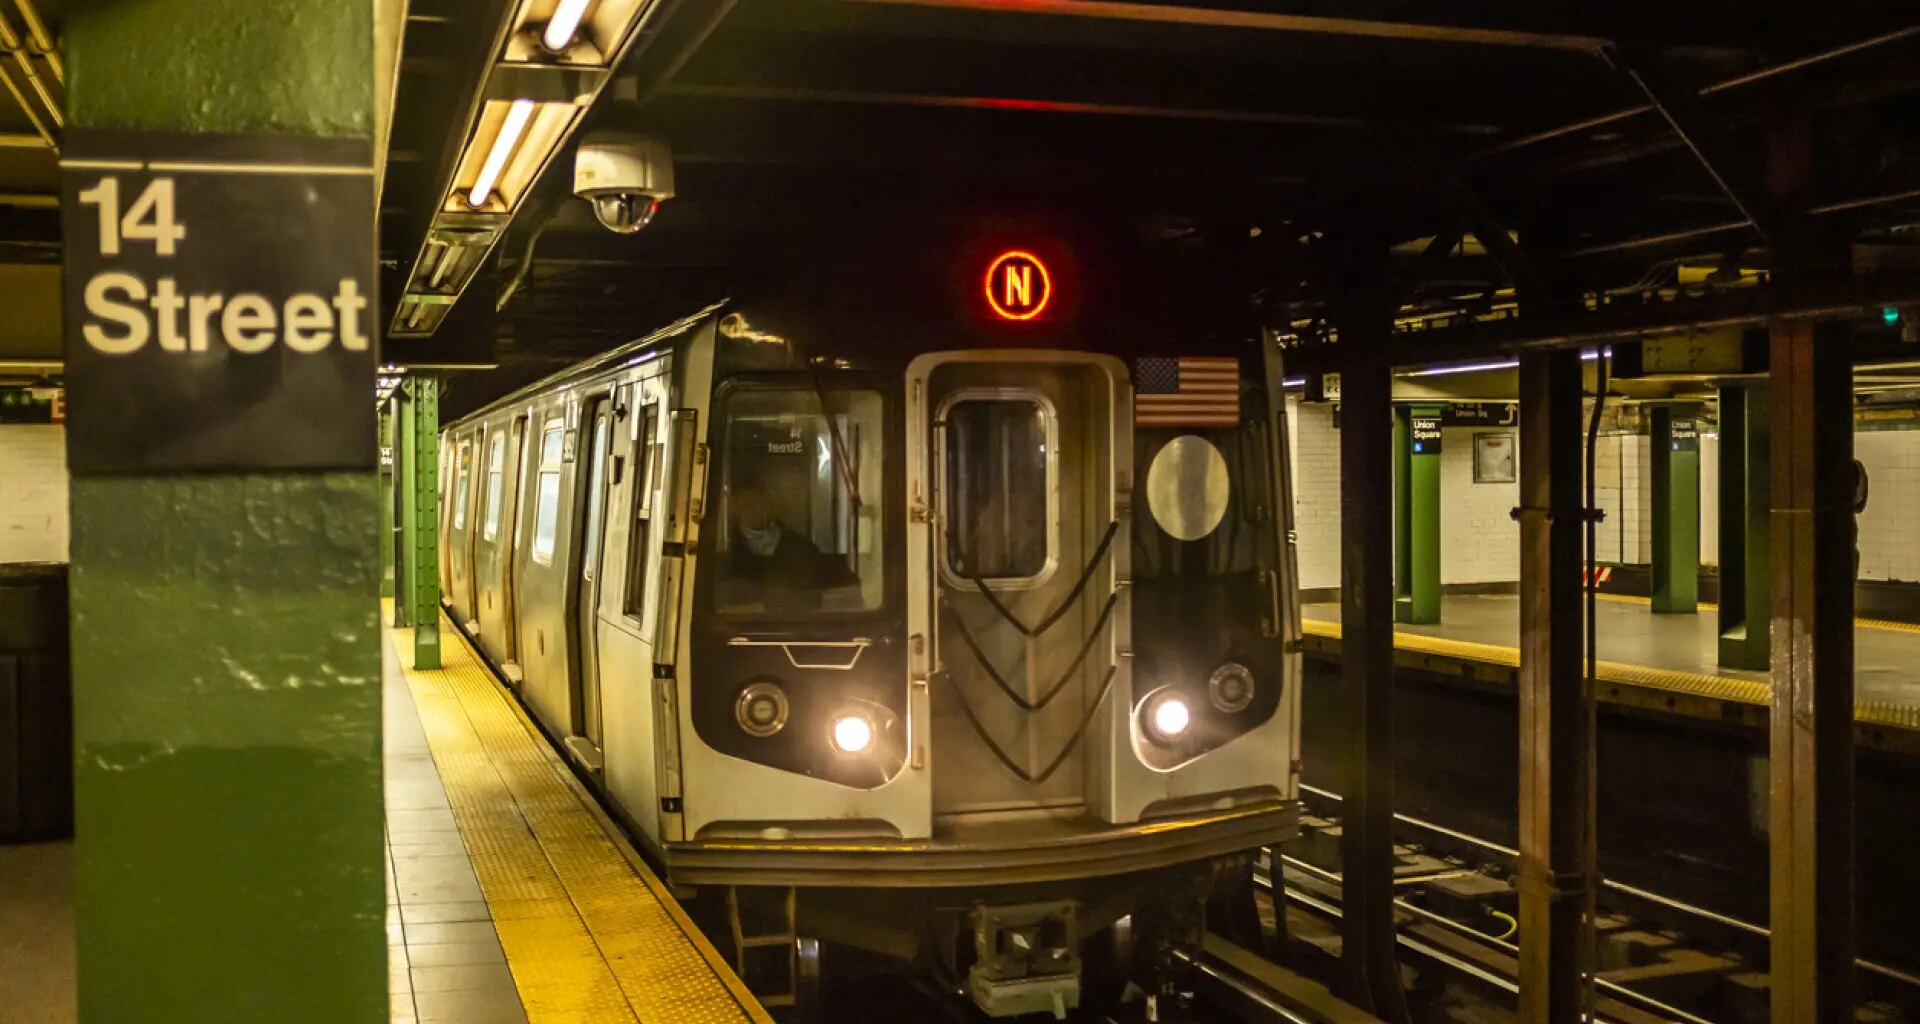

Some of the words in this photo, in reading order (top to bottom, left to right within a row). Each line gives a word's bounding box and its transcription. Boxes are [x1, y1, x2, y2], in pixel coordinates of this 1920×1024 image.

[79, 177, 186, 256] 14
[1006, 265, 1031, 307] N
[82, 272, 369, 354] Street
[1413, 420, 1436, 429] Union
[1671, 421, 1692, 429] Union
[1414, 430, 1442, 440] Square
[1671, 430, 1696, 439] Square
